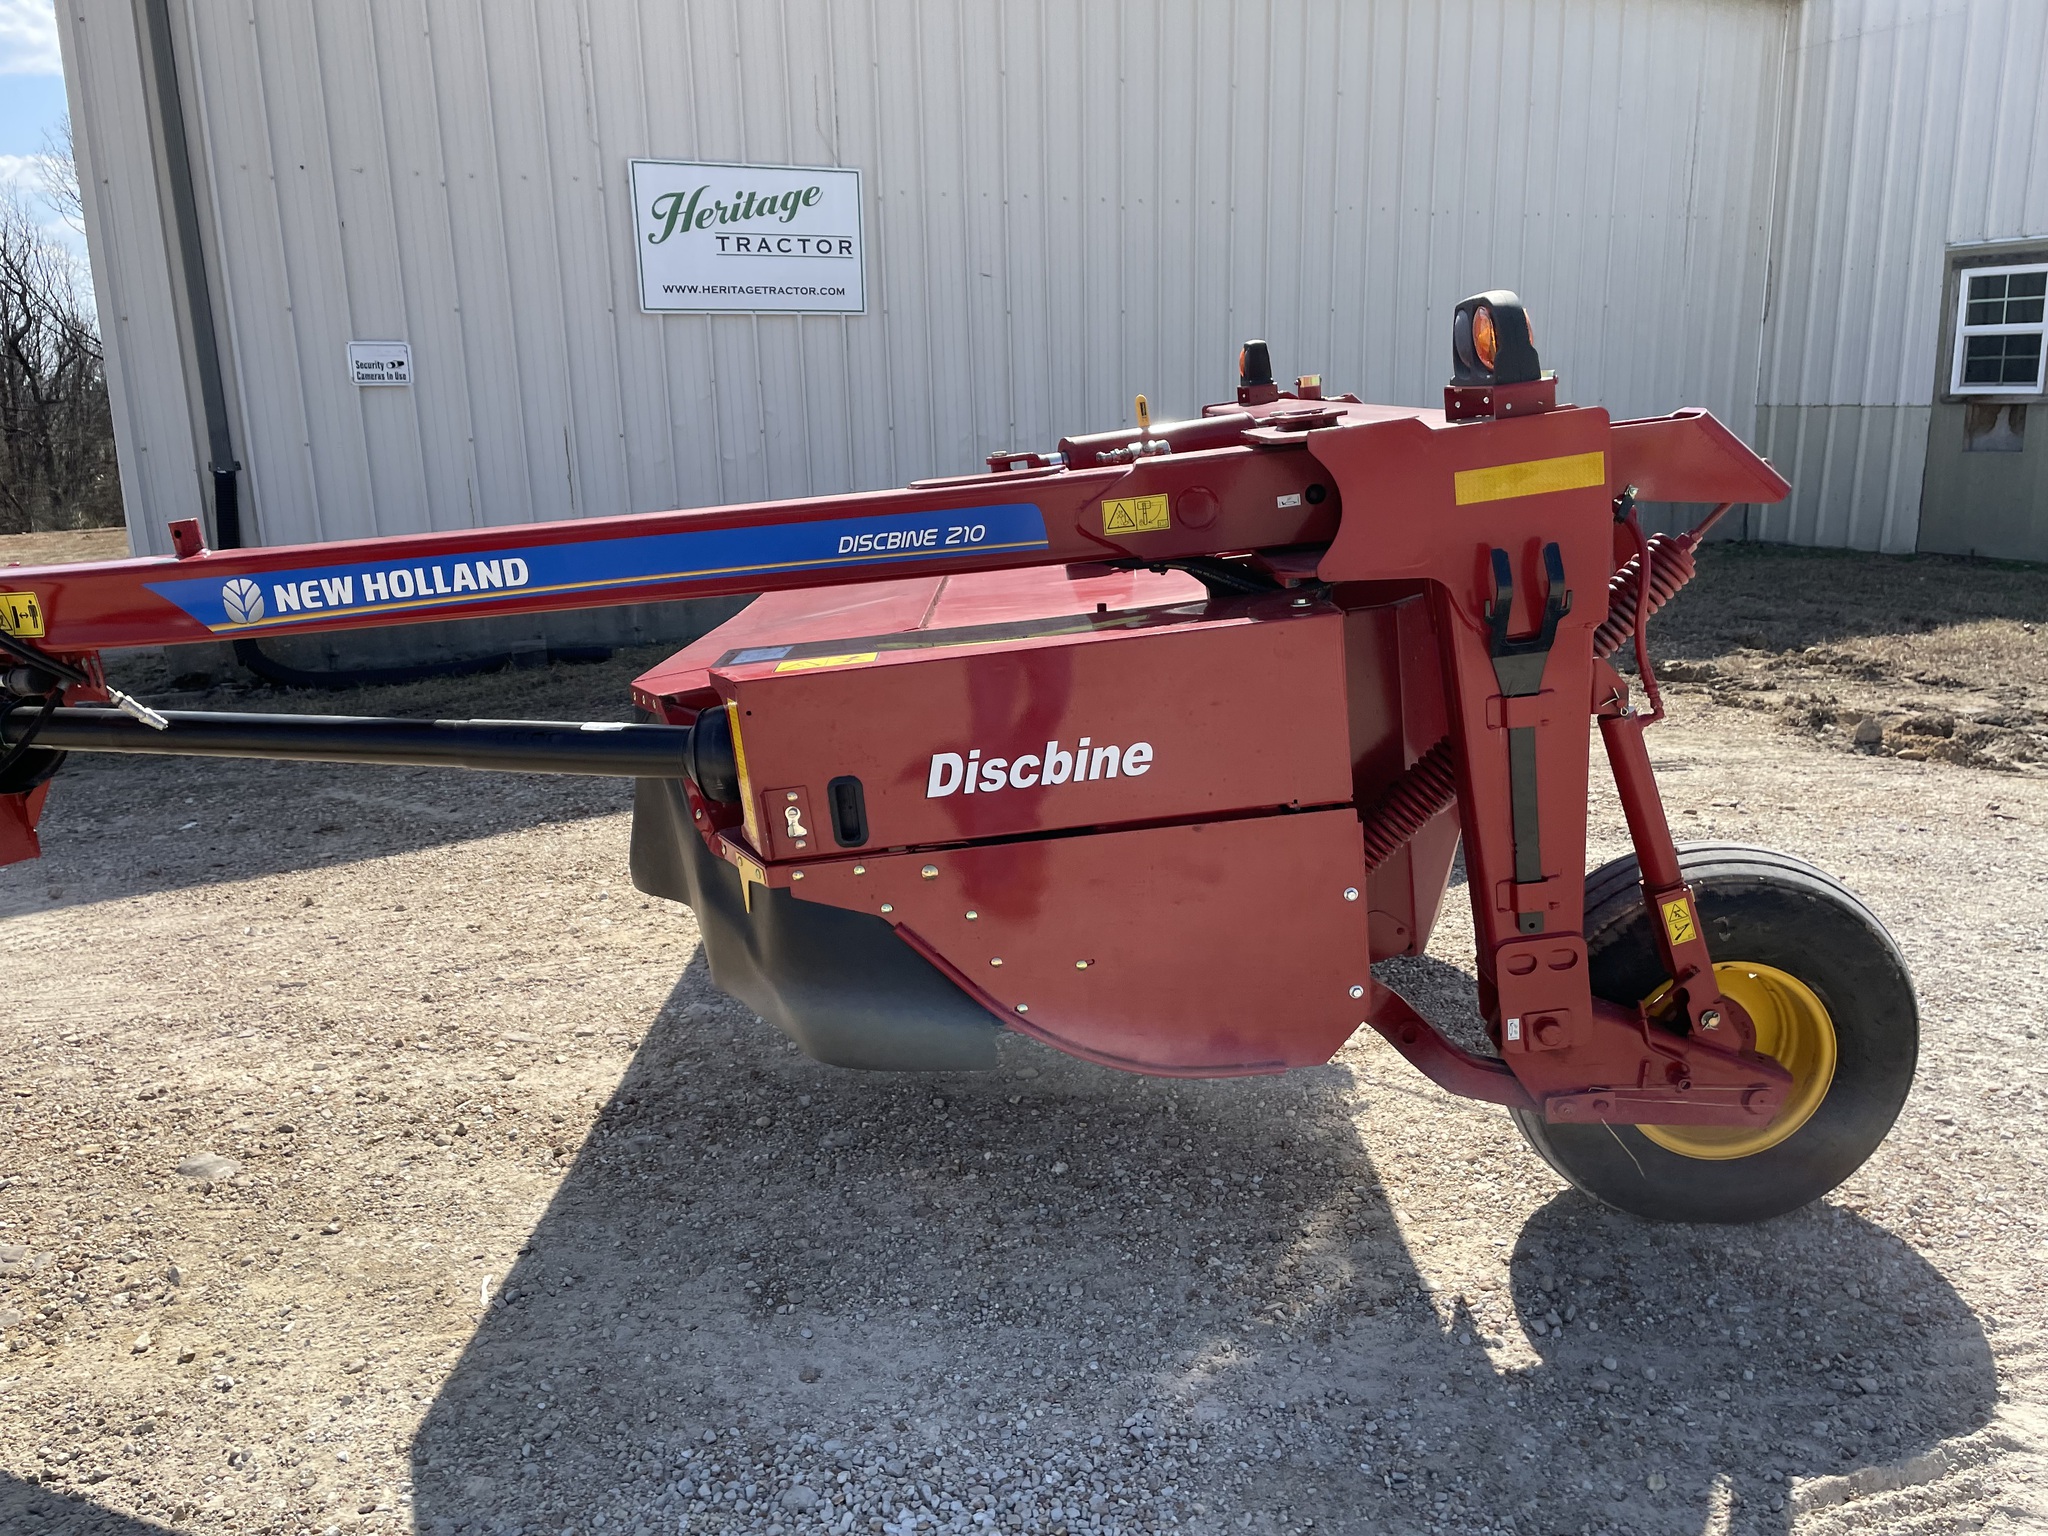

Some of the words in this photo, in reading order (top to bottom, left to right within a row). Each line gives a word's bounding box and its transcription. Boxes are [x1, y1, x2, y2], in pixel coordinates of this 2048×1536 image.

[648, 185, 823, 244] Heritage
[715, 236, 853, 255] TRACTOR
[662, 284, 845, 296] WWW.HERITAGETRACTOR.COM
[355, 360, 384, 371] Security
[356, 371, 385, 380] Cameras
[386, 371, 393, 380] In
[394, 371, 406, 380] Use
[838, 527, 939, 555] DISCBINE
[945, 524, 986, 545] 210
[273, 575, 354, 613] NEW
[361, 557, 530, 602] HOLLAND
[926, 736, 1154, 799] Discbine
